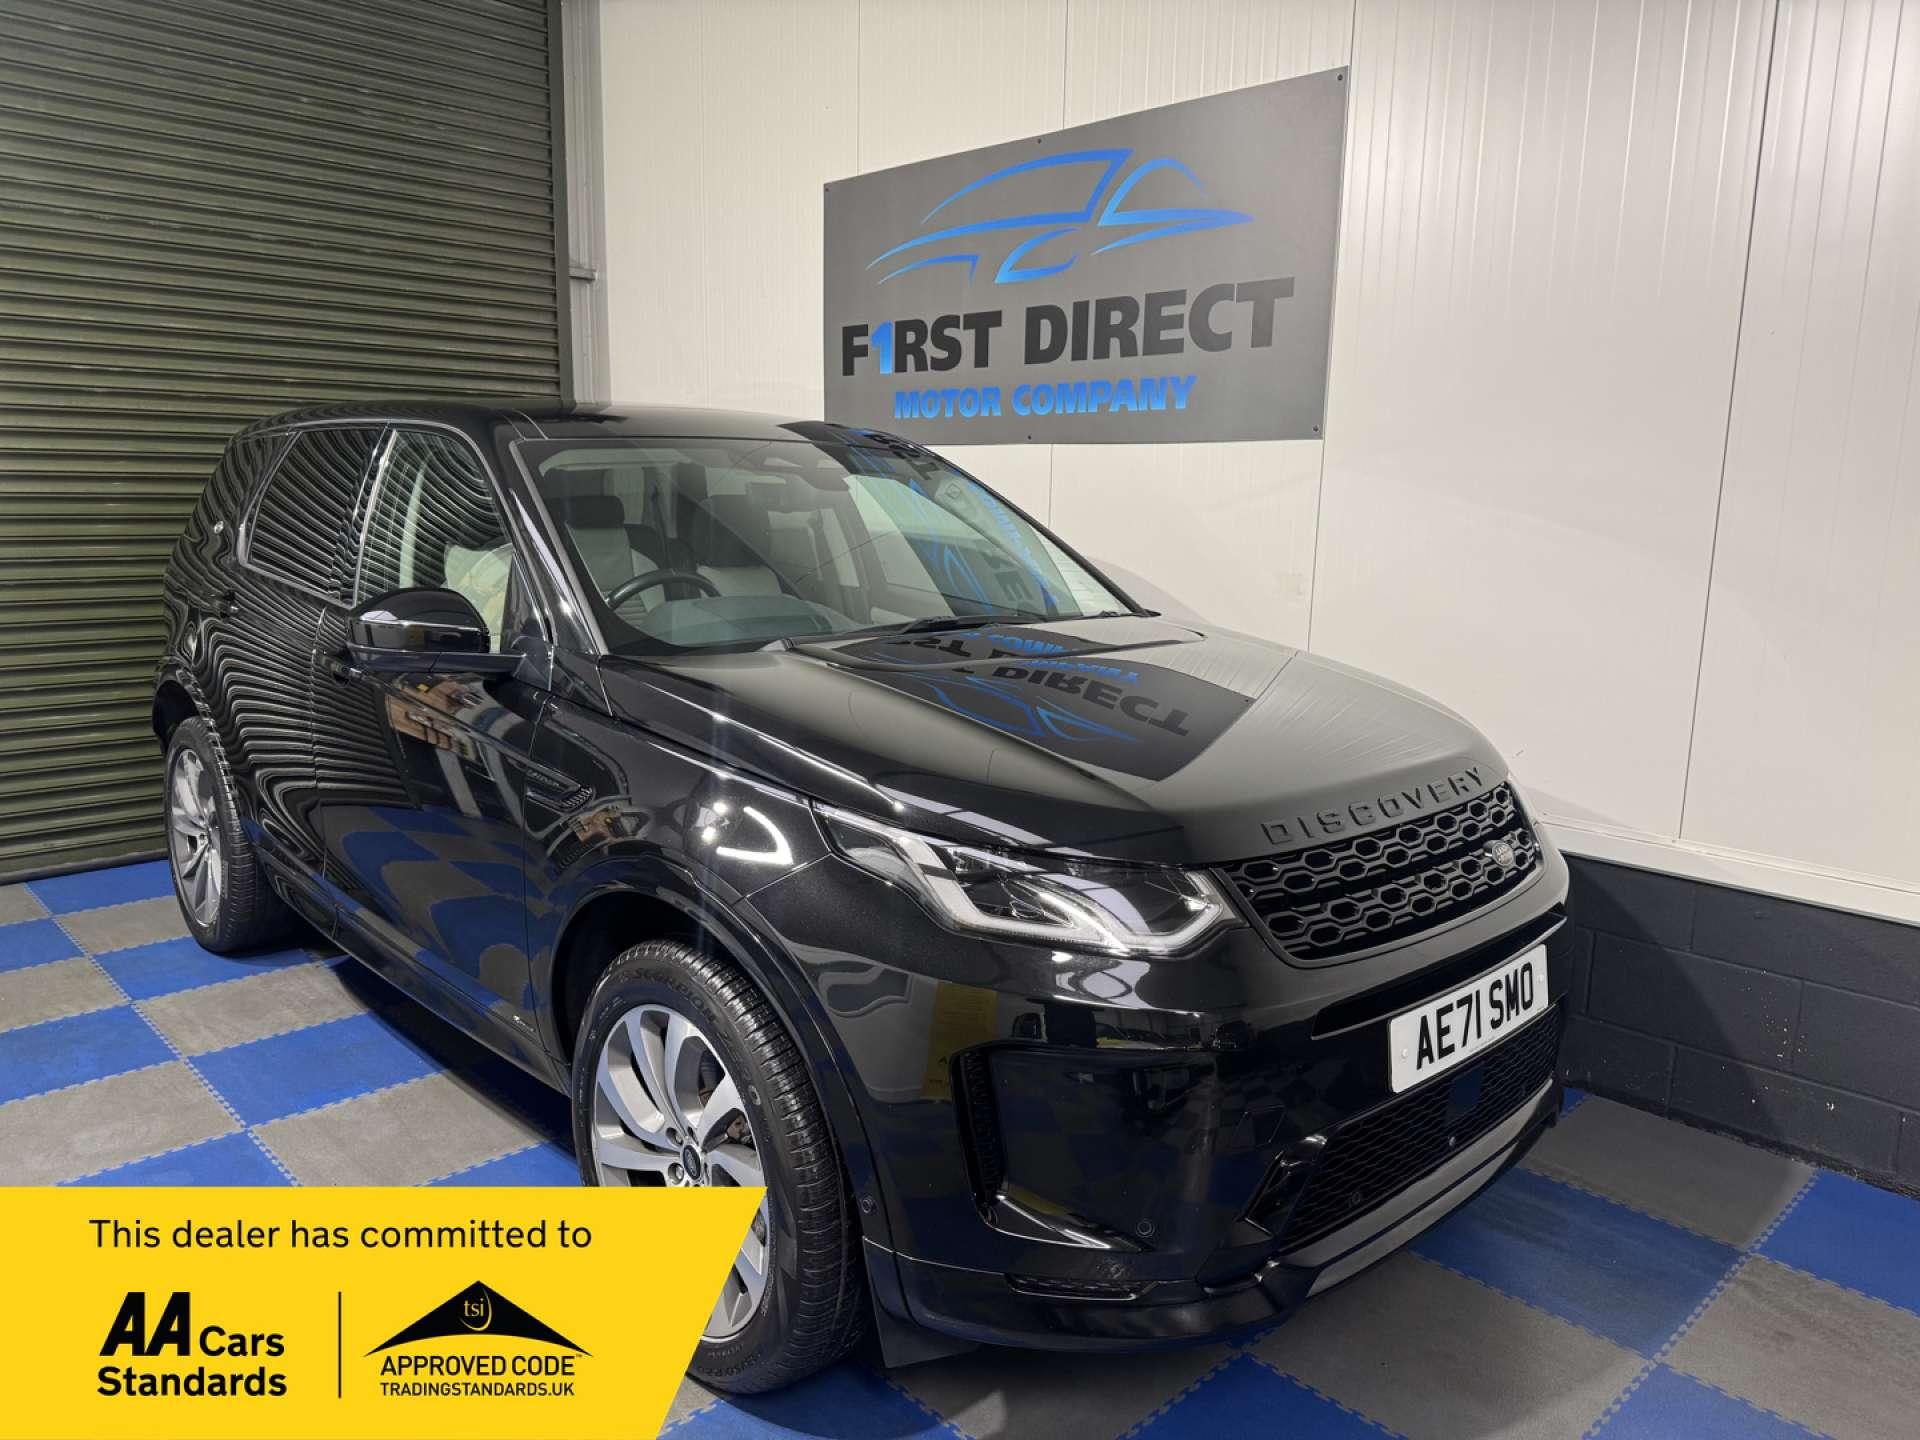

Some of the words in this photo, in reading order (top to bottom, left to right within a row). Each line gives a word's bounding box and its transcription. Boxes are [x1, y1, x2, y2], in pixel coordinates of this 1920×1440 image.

[842, 309, 1003, 376] F1RST
[1023, 277, 1295, 365] DIRECT
[895, 386, 1002, 419] MOTOR
[1012, 374, 1198, 417] COMPANY
[1260, 766, 1485, 846] DISCOVERY
[1416, 989, 1482, 1071] AE71
[1488, 961, 1534, 1030] SMO
